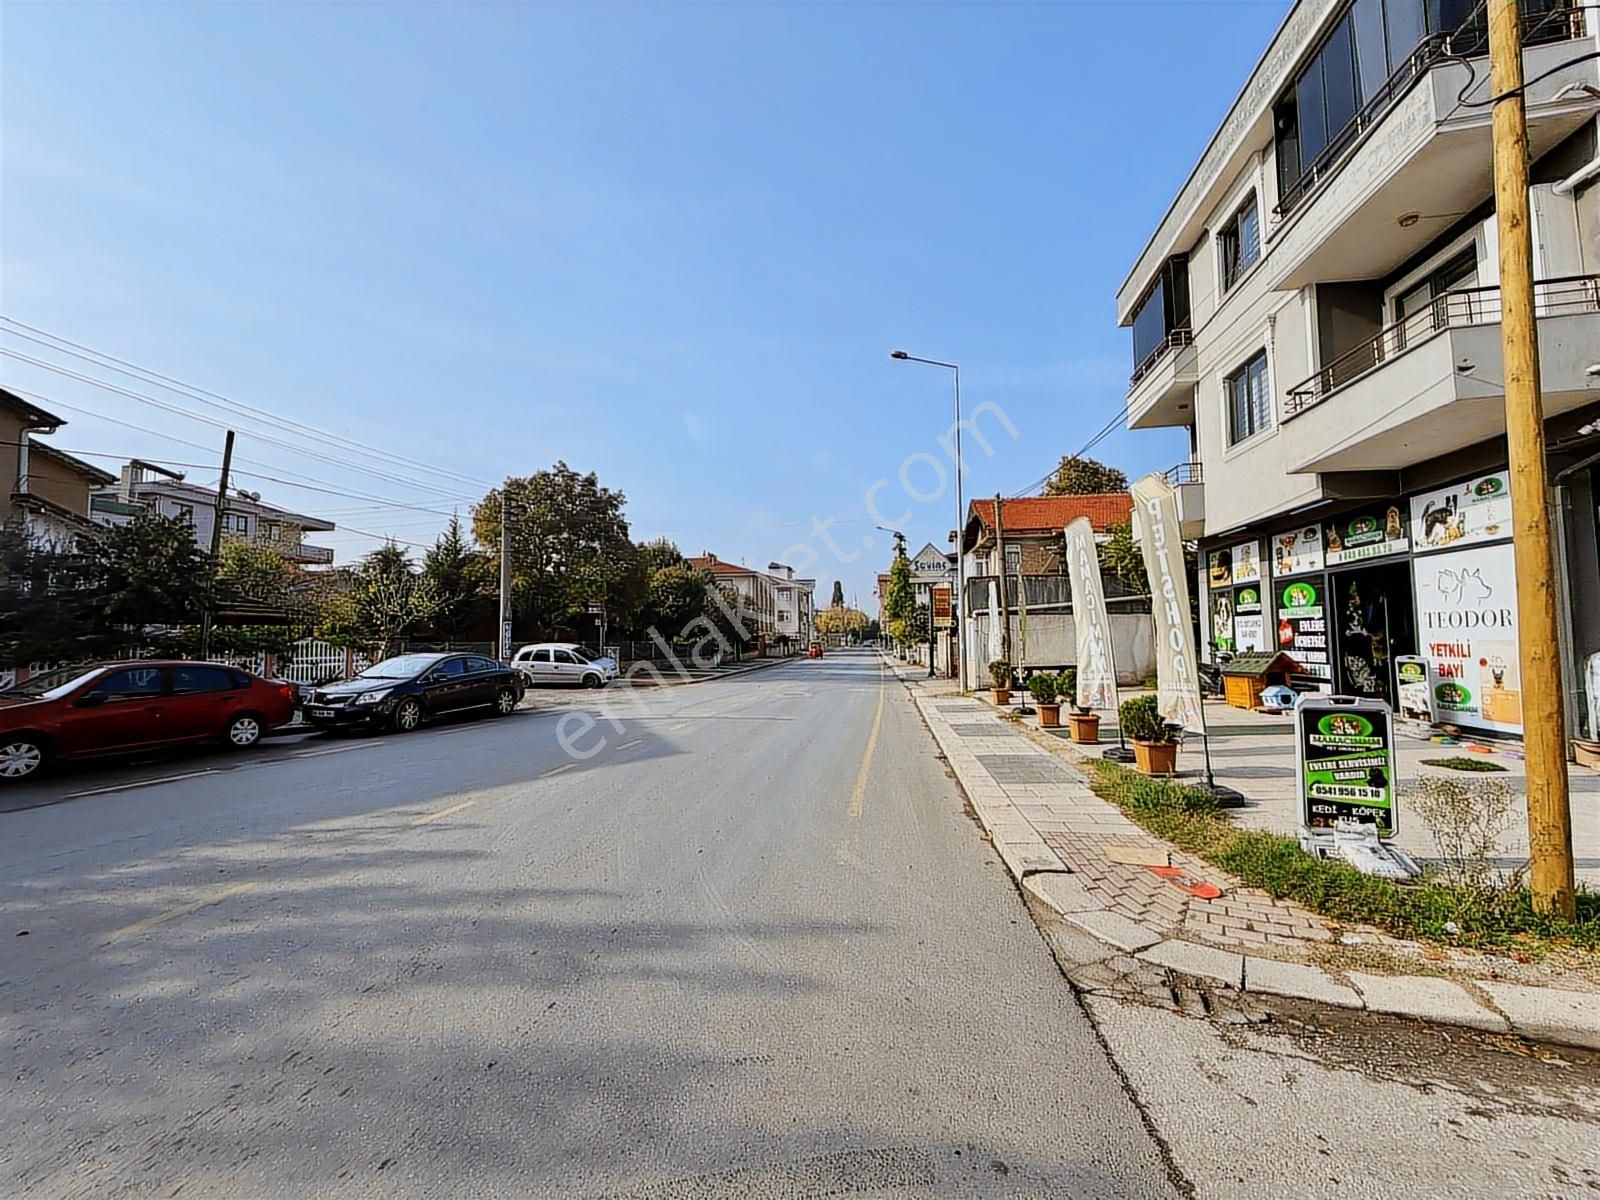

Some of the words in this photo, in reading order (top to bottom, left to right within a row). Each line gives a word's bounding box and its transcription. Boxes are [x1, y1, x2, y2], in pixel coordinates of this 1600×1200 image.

[1424, 608, 1512, 629] TEODOR
[1429, 638, 1472, 659] YETKİLİ
[1438, 660, 1465, 679] BAYİ
[1312, 804, 1338, 814] KEDİ
